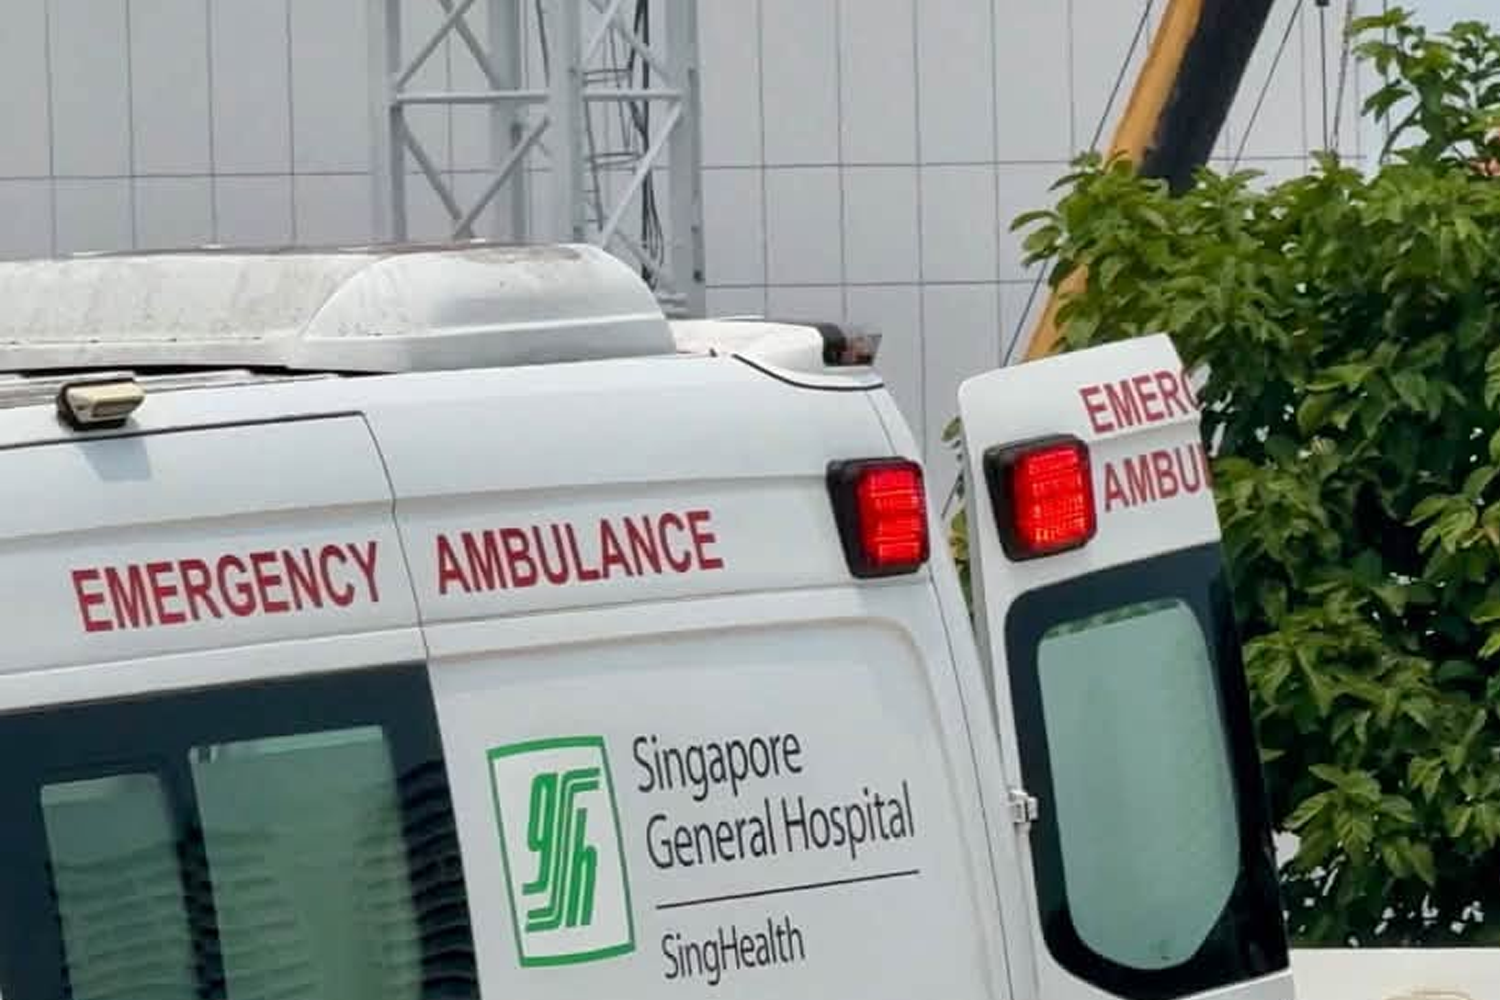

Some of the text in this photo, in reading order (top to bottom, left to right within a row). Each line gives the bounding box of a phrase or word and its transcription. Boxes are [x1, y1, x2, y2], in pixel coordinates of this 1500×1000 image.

[72, 510, 724, 633] EMERGENCY AMBULANCE
[633, 733, 803, 801] Singapore
[646, 780, 915, 869] General Hospital
[661, 915, 806, 986] SingHealth
